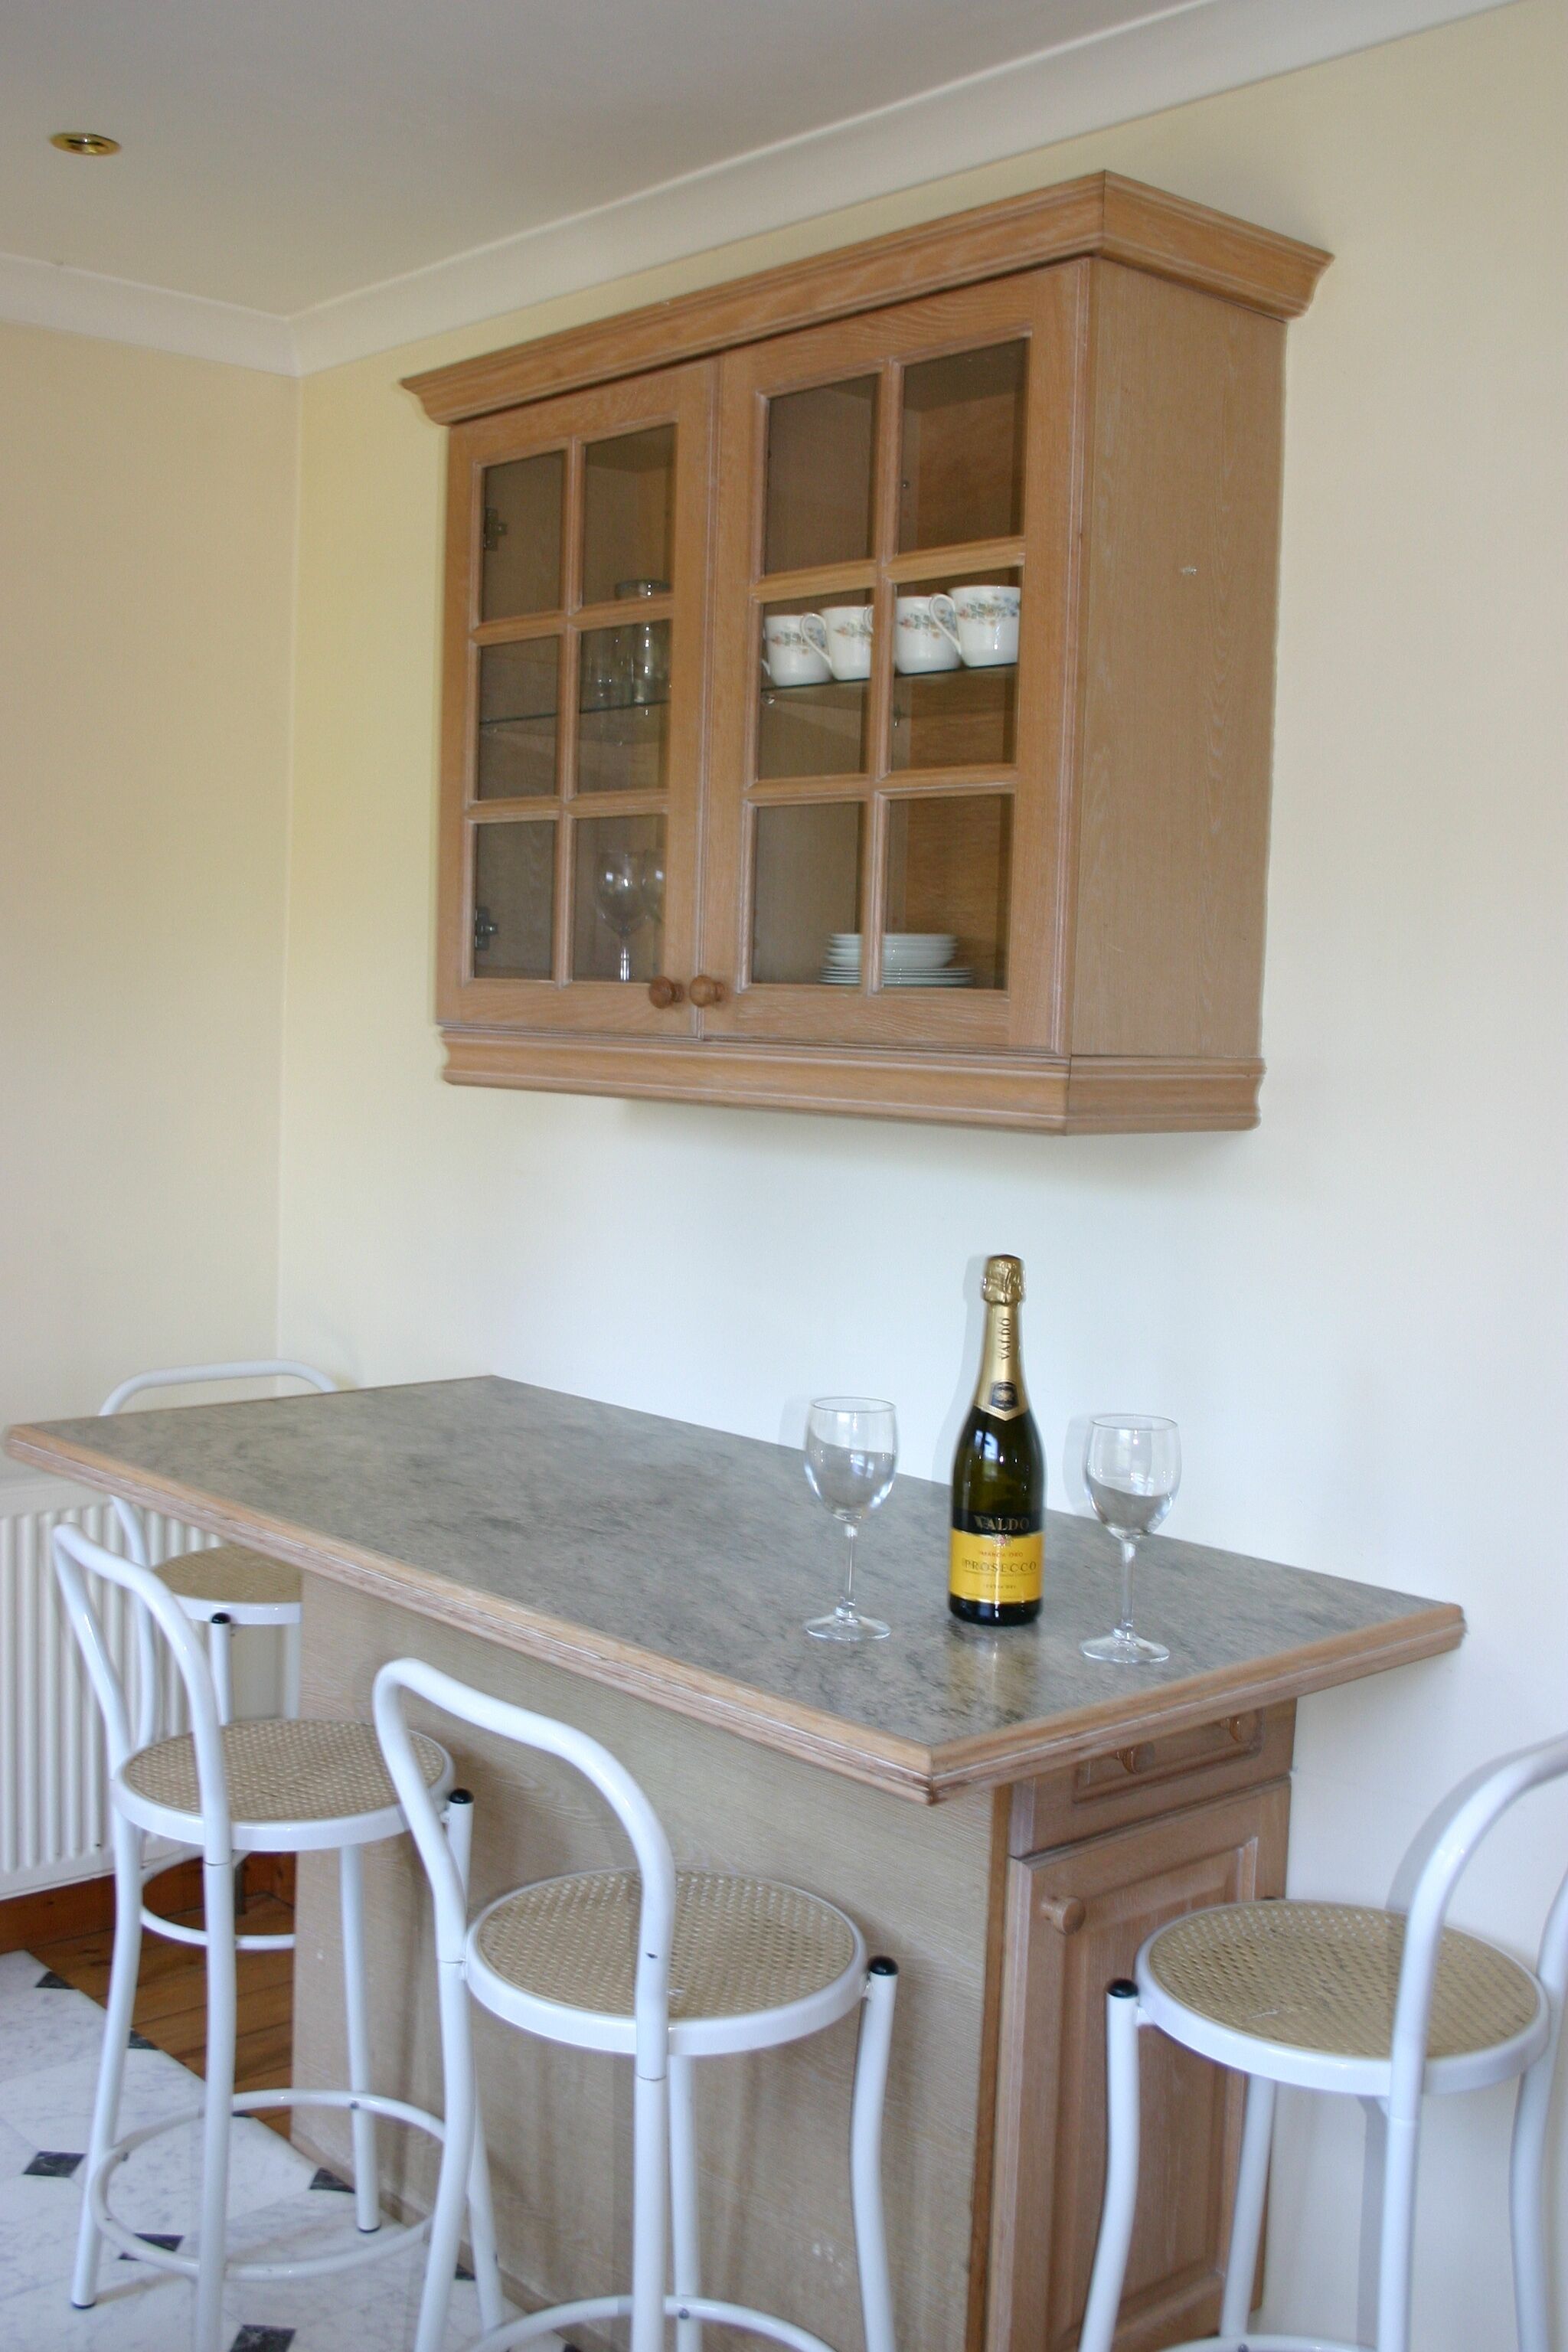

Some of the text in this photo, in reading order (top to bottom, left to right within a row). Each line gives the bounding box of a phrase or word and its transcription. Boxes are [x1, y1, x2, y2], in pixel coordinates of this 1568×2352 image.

[999, 1318, 1011, 1360] VALDO
[974, 1515, 1029, 1530] VALDO
[964, 1560, 1037, 1573] PROSECCO
